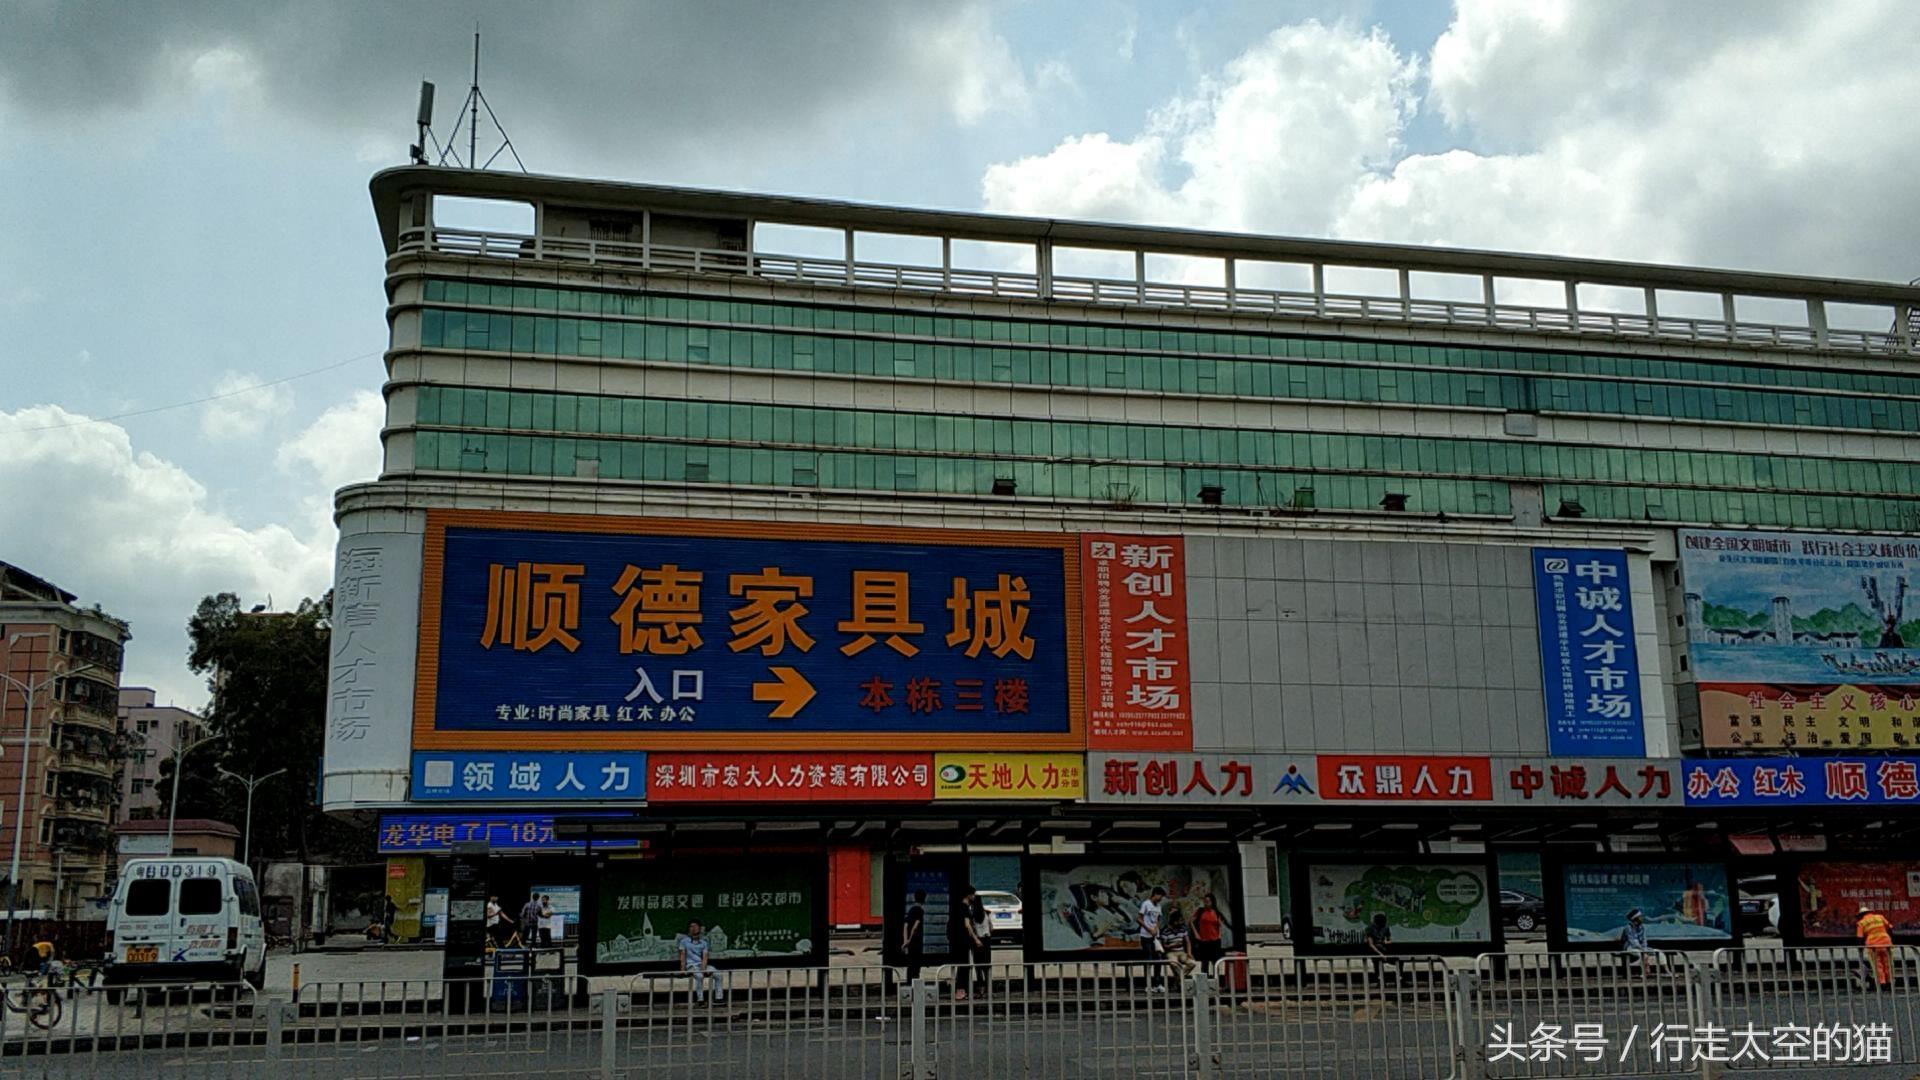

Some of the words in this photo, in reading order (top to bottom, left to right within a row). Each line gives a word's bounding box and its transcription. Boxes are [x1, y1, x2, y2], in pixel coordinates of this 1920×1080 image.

[1685, 535, 1791, 554] 创建全国文明城市
[480, 562, 1036, 660] 顺德家具城
[1120, 544, 1180, 710] 新创人才市场
[1575, 560, 1631, 719] 中诚人才市场
[624, 668, 703, 703] 入口
[859, 675, 1030, 714] 本栋三楼
[1748, 690, 1916, 711] 社会主义核心
[617, 704, 653, 722] 红木
[660, 704, 696, 722] 办公
[1729, 715, 1762, 727] 富强
[1784, 715, 1816, 727] 民主
[1838, 716, 1870, 728] 文明
[1731, 732, 1763, 744] 公正
[1840, 732, 1871, 745] 爱国
[463, 761, 630, 792] 领域人力
[655, 763, 929, 788] 深圳市宏大人力资源有限公司
[968, 763, 1059, 790] 天地人力
[1103, 760, 1253, 796] 新创人力
[1338, 764, 1473, 795] 众鼎人力
[1510, 764, 1670, 799] 中诚人力
[1688, 767, 1740, 798] 办公
[1753, 766, 1806, 798] 红木
[1825, 762, 1920, 799] 顺德
[617, 894, 704, 910] 发展品质交通
[717, 891, 802, 908] 建设公交都市
